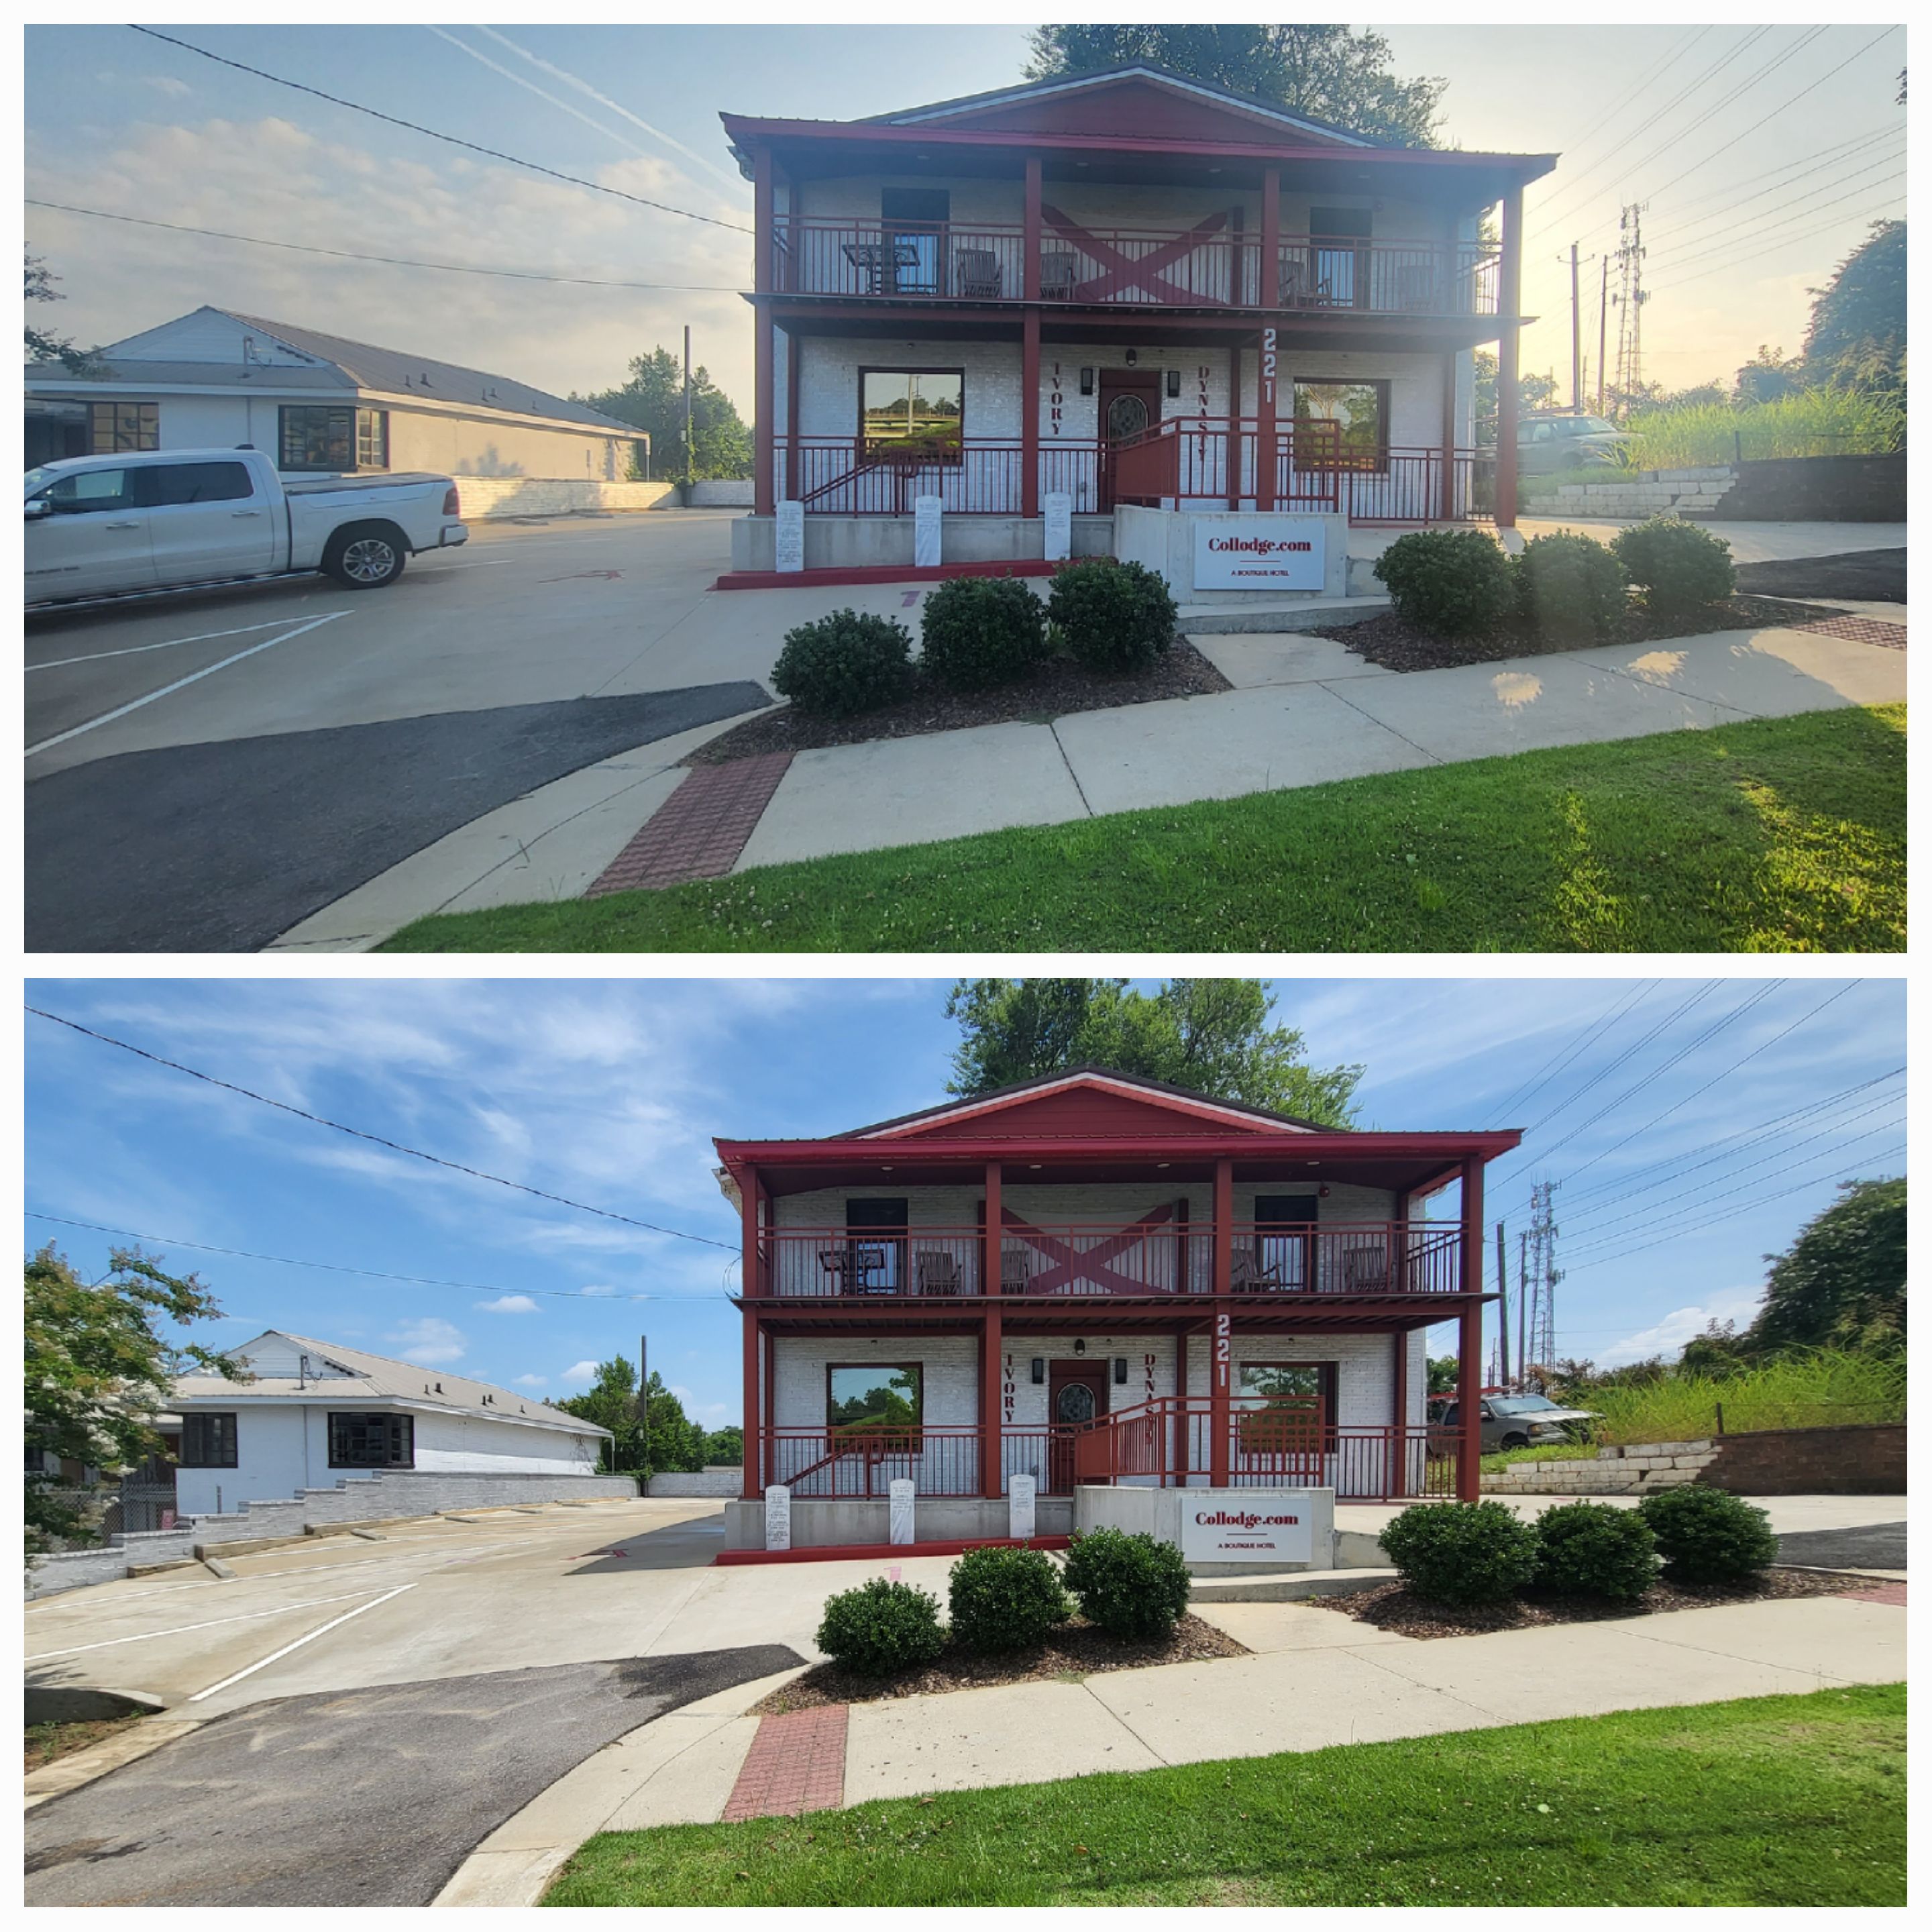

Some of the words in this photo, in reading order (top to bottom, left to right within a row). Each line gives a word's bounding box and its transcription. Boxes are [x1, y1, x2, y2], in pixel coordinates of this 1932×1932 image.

[1051, 363, 1063, 435] IVORY
[1264, 328, 1277, 403] 221
[1209, 537, 1311, 555] Collodge.com
[1218, 1314, 1230, 1387] 221
[1004, 1354, 1015, 1422] IVORY
[1195, 1511, 1299, 1529] Collodge.com
